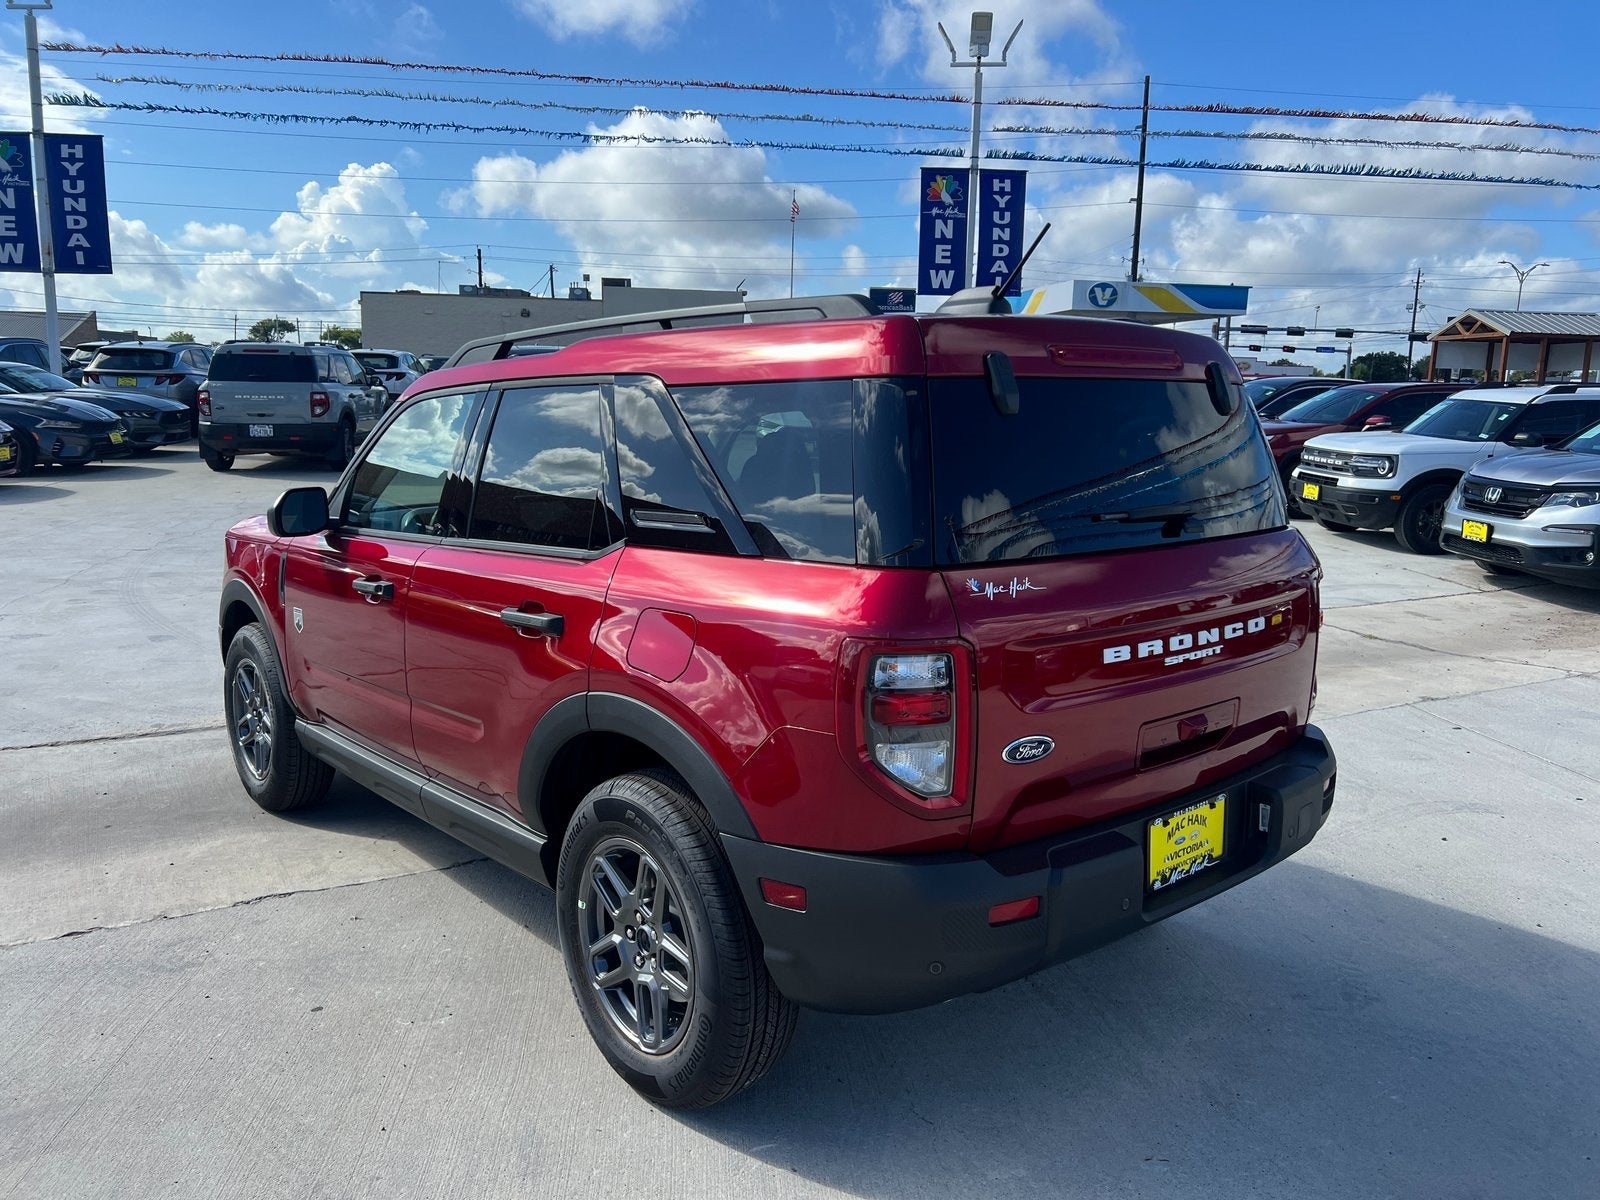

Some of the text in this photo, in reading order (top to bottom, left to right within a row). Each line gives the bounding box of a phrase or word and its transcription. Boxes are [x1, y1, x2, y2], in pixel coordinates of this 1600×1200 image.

[60, 144, 91, 265] HYUNDAI
[0, 187, 25, 264] NEW
[990, 178, 1011, 287] HYUNDAI
[929, 219, 955, 289] NEW
[1303, 454, 1343, 466] BRONCO
[973, 577, 1041, 601] Mac Haik
[1102, 615, 1266, 665] BRONCO
[1164, 645, 1224, 667] SPORT
[1015, 741, 1046, 761] Ford
[1166, 813, 1208, 844] MAC HAIK
[1169, 840, 1203, 862] VICTORIA
[675, 1012, 713, 1089] Continental
